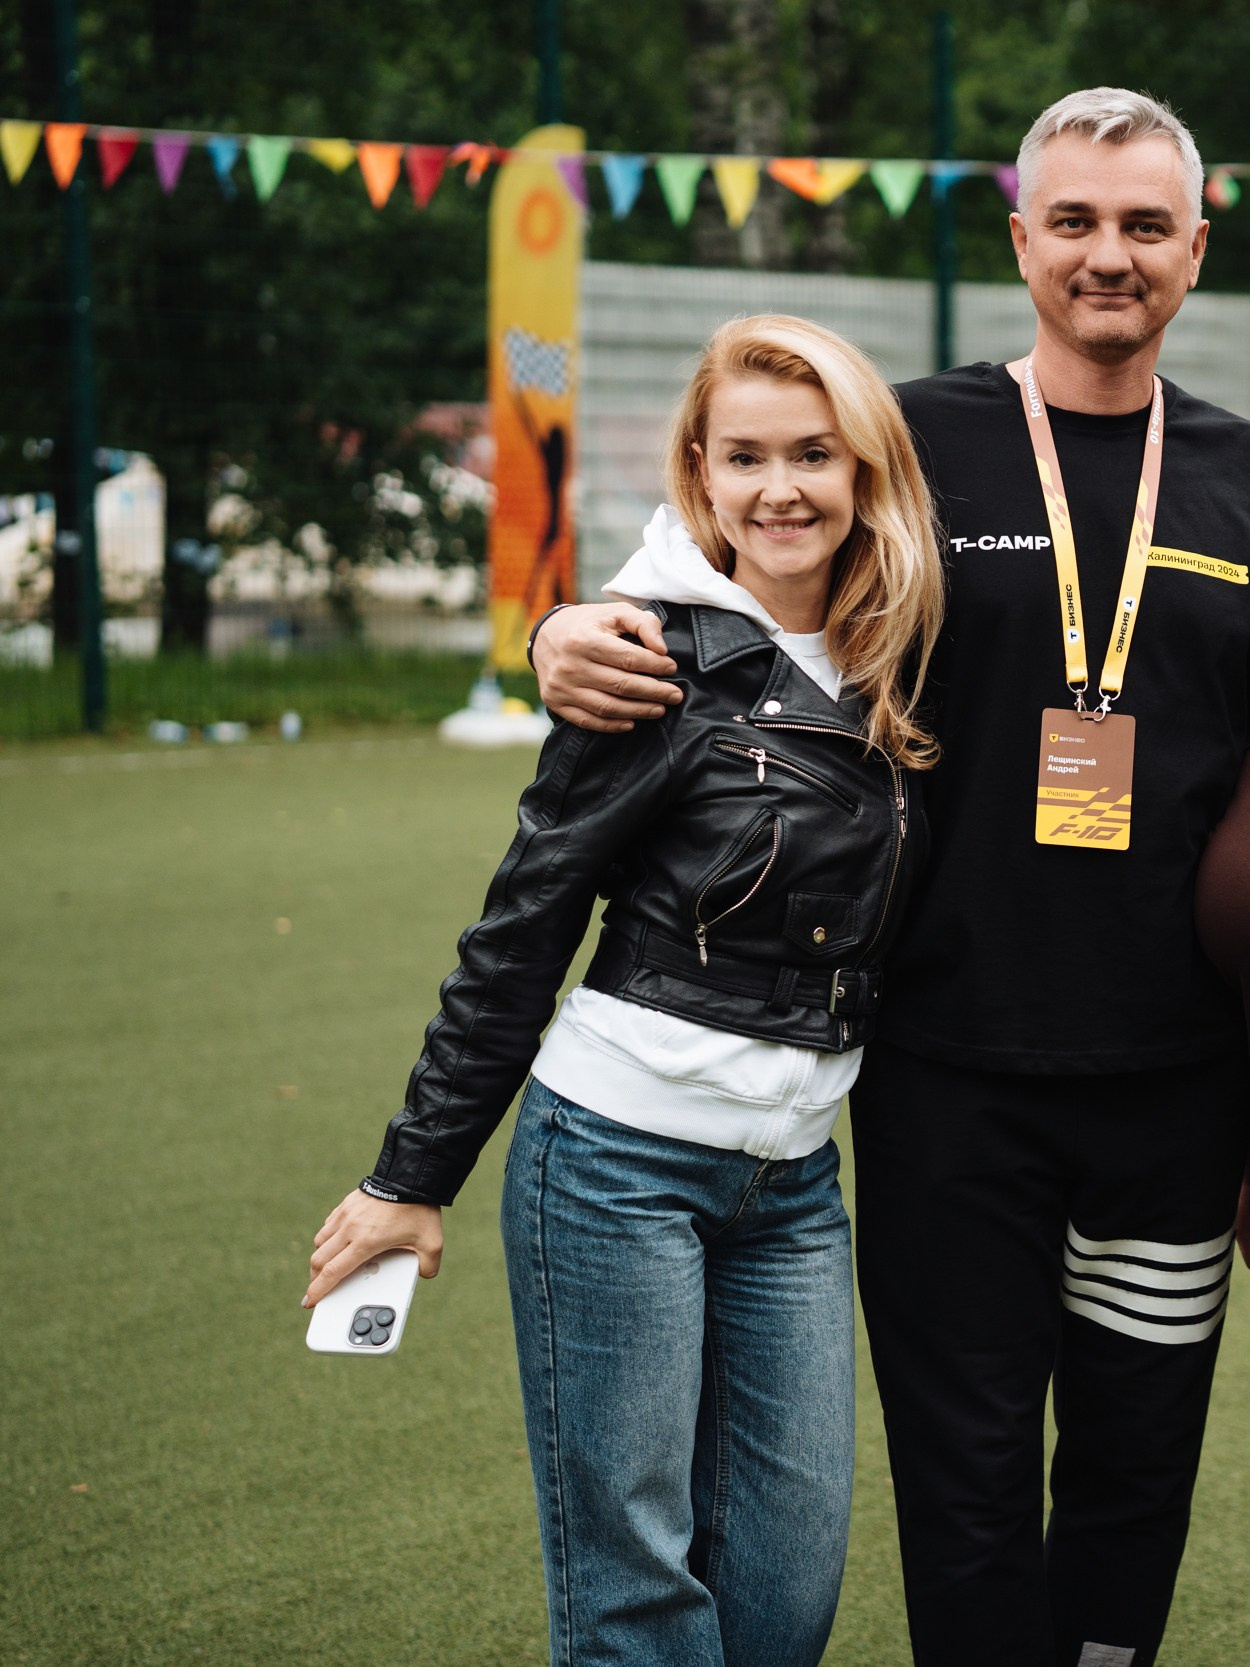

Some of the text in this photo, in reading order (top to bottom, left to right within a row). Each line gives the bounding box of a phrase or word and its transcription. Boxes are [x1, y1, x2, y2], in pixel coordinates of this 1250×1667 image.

[950, 535, 1051, 553] T-CAMP
[1147, 551, 1240, 578] Калининград 2024
[1065, 583, 1076, 627] БИЗНЕС
[1115, 611, 1131, 654] БИЗНЕС
[1059, 736, 1086, 744] БИЗНЕС
[1046, 764, 1080, 774] Андрей
[1047, 755, 1097, 766] Лещинский
[1046, 789, 1080, 799] Участник
[1049, 822, 1123, 841] F-10
[362, 1181, 398, 1201] T-Business
